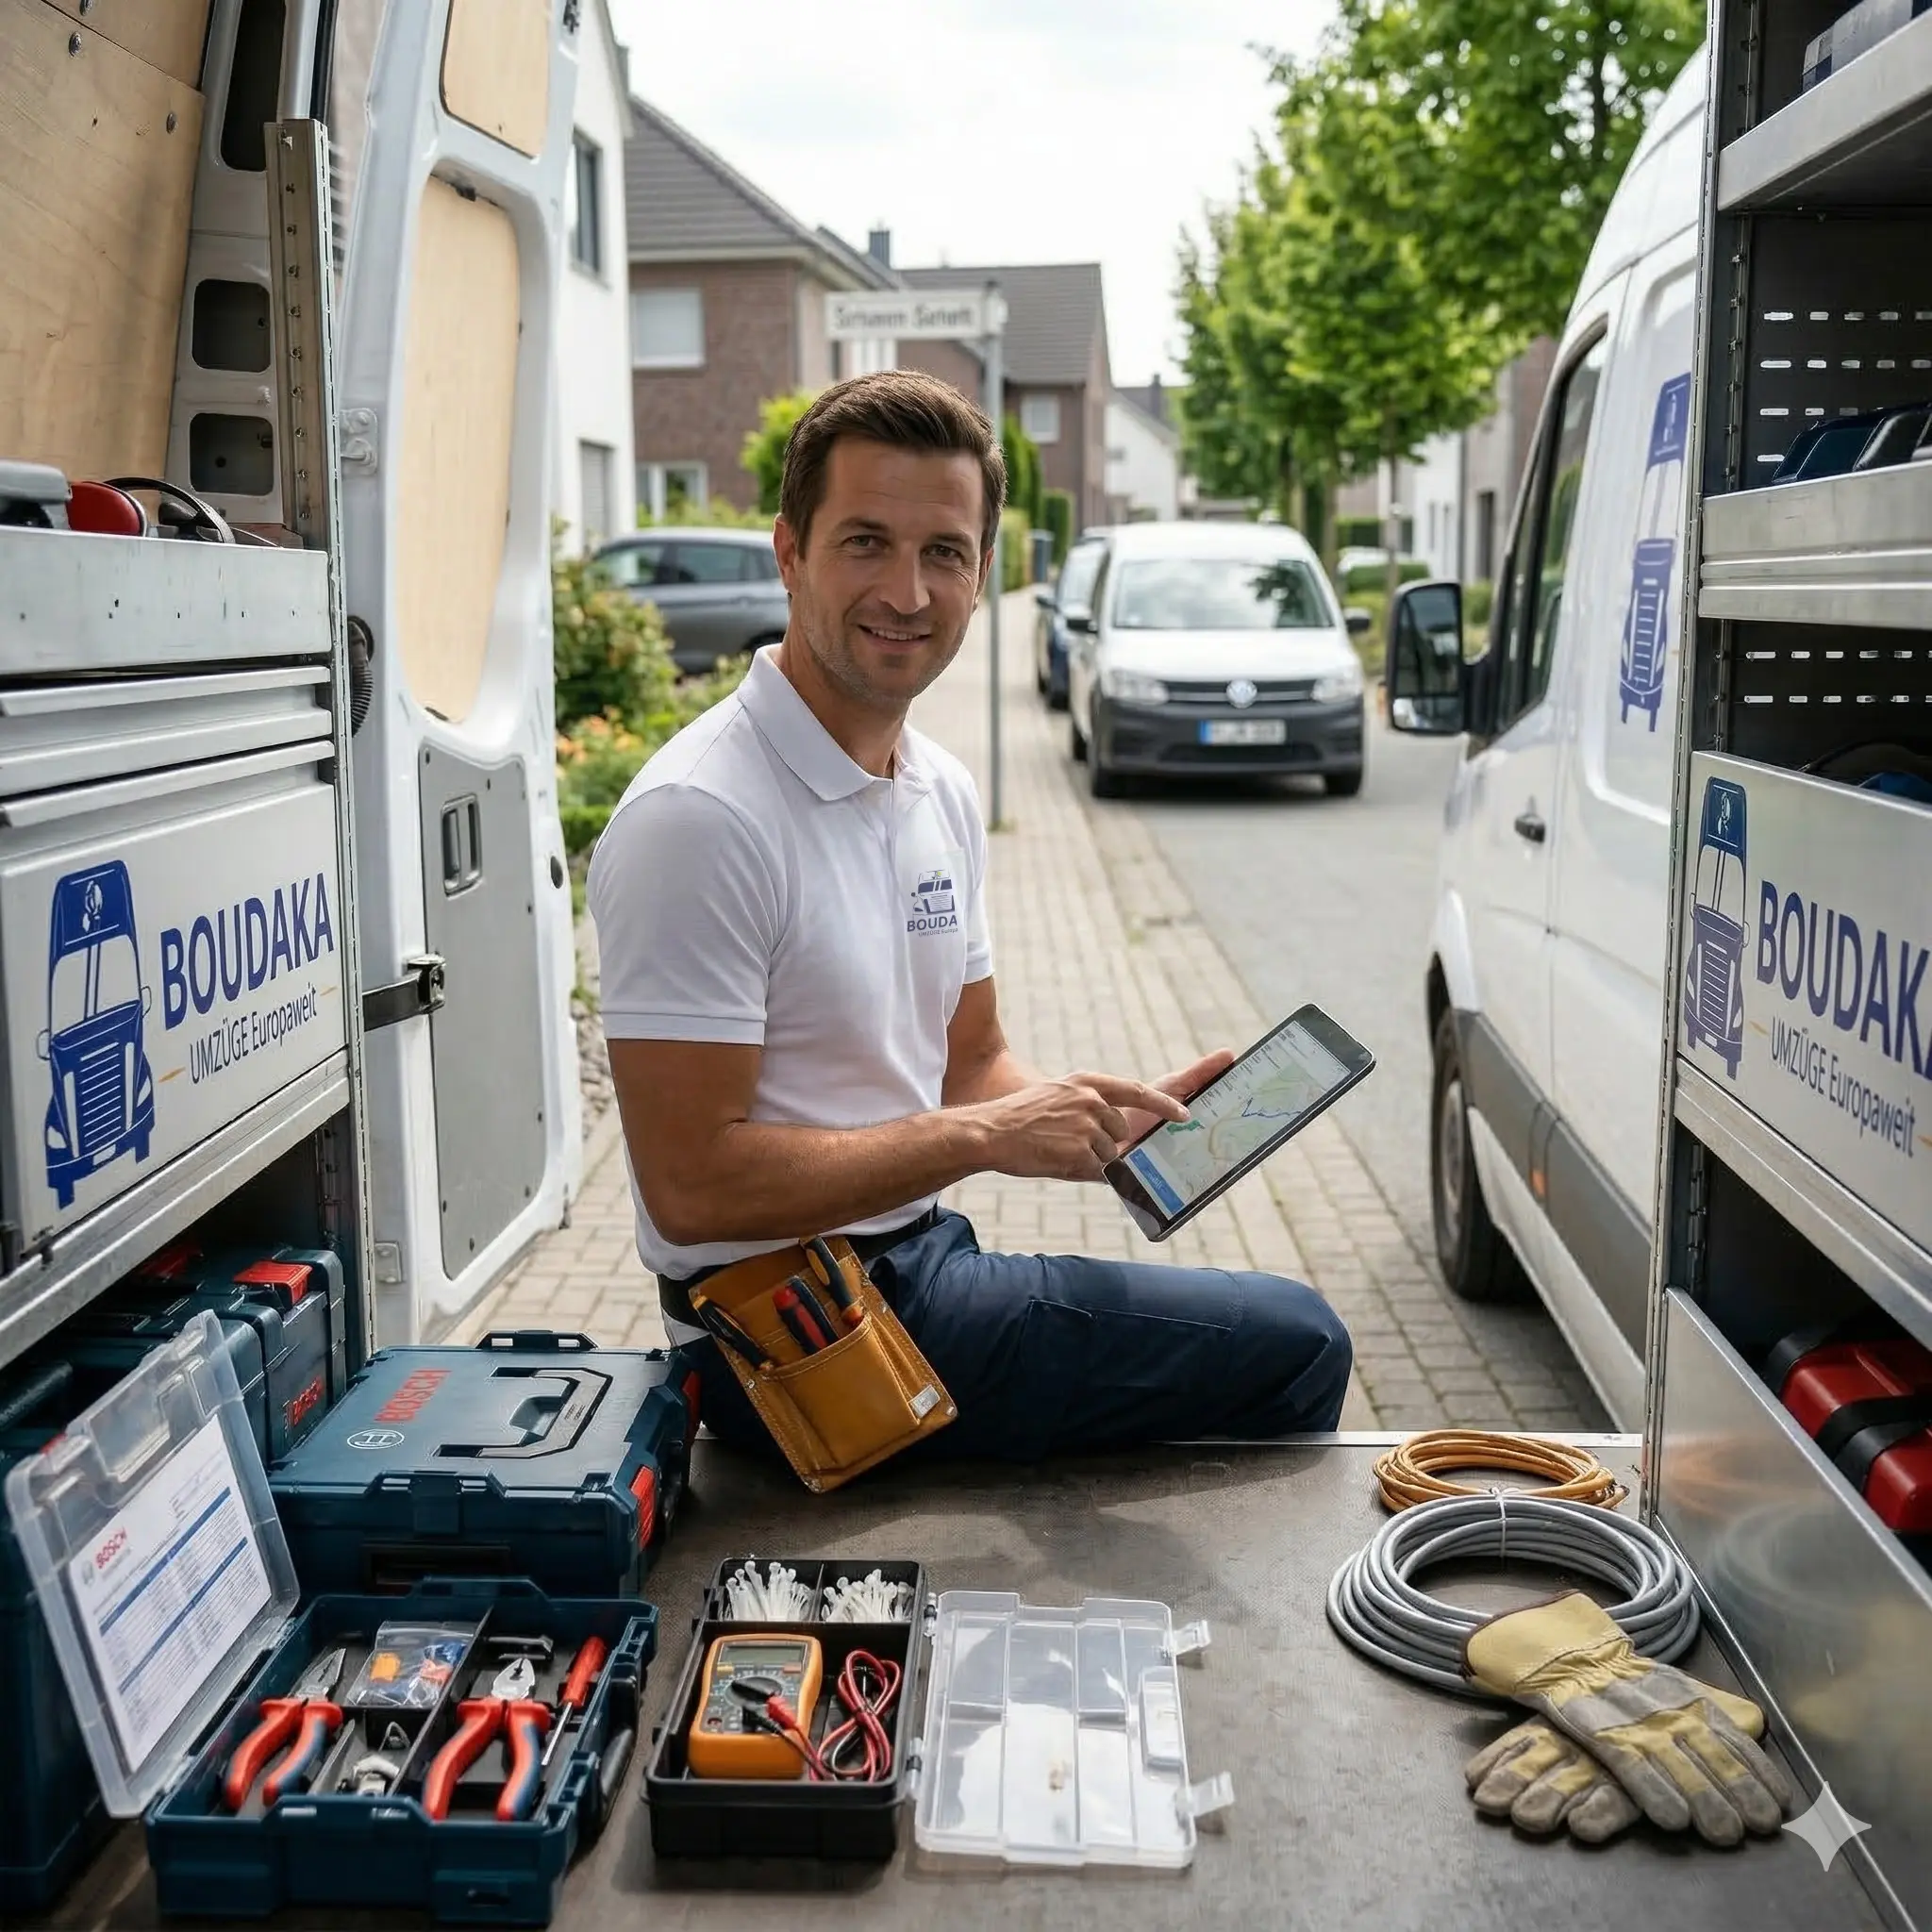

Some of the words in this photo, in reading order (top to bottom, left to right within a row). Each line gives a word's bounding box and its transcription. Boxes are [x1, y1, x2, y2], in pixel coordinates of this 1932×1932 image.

[160, 873, 334, 1030] BOUDAKA
[907, 914, 958, 932] BOUDA
[1757, 879, 1932, 1081] BOUDAK
[190, 1017, 248, 1084] UMZÜGE
[253, 982, 317, 1051] Europaweit
[1771, 1017, 1826, 1095] UMZÜGE
[1829, 1055, 1916, 1158] Europaweit
